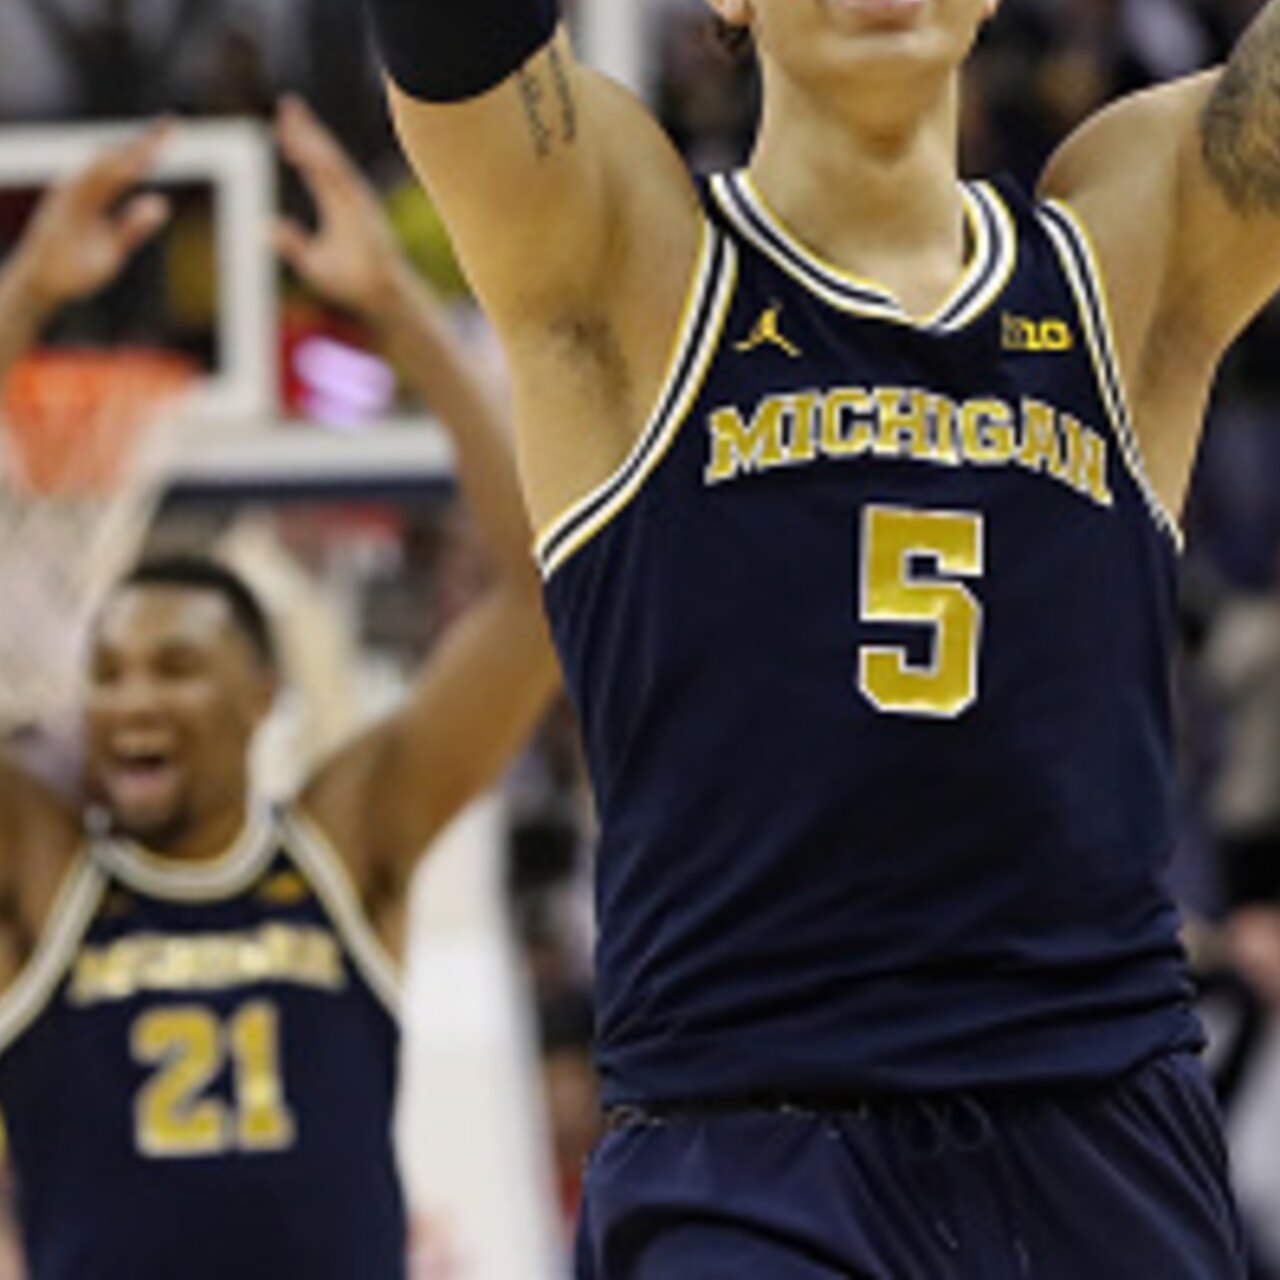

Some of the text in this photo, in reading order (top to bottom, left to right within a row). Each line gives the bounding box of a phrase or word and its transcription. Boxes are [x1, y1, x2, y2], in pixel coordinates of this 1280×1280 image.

[704, 387, 1114, 507] MICHIGAN
[858, 504, 984, 718] 5
[130, 1001, 296, 1158] 21
